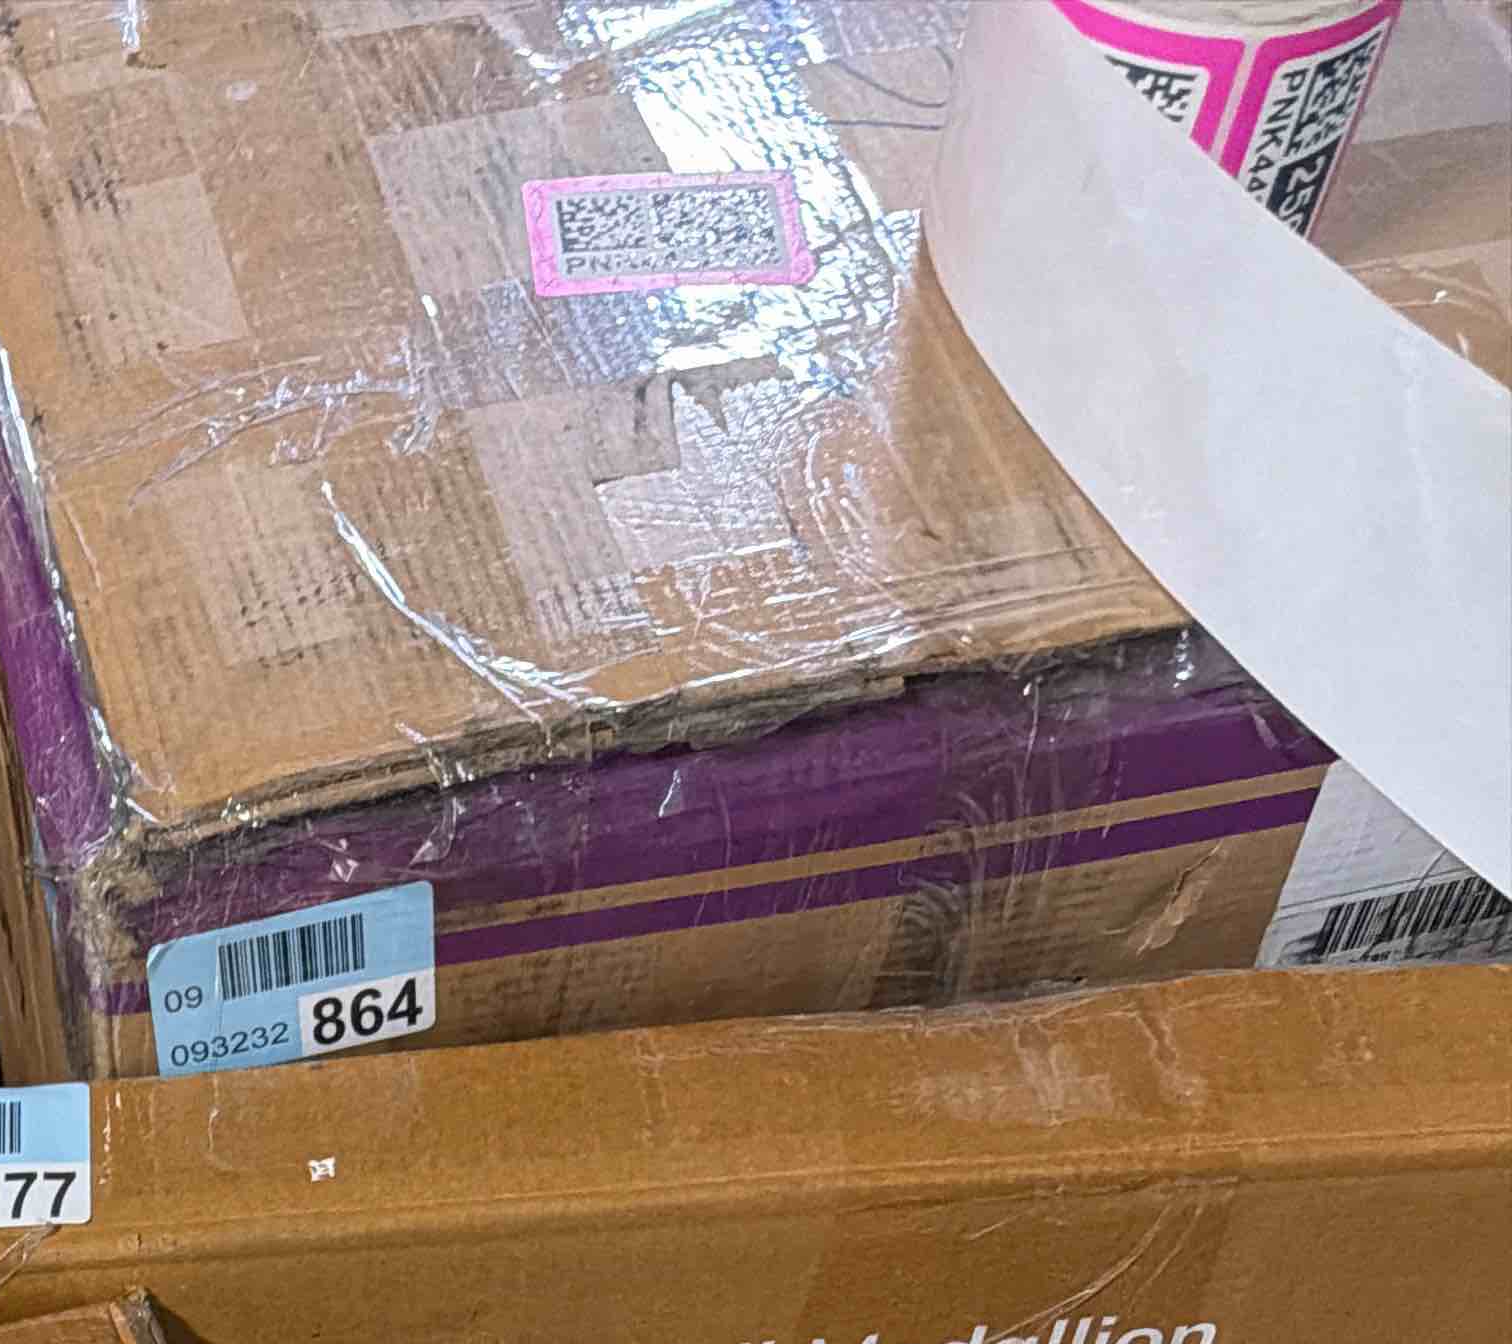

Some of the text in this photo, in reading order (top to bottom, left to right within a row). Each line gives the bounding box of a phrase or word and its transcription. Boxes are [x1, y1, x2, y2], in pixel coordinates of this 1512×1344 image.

[164, 985, 204, 1013] 09
[170, 976, 424, 1067] 093232 864
